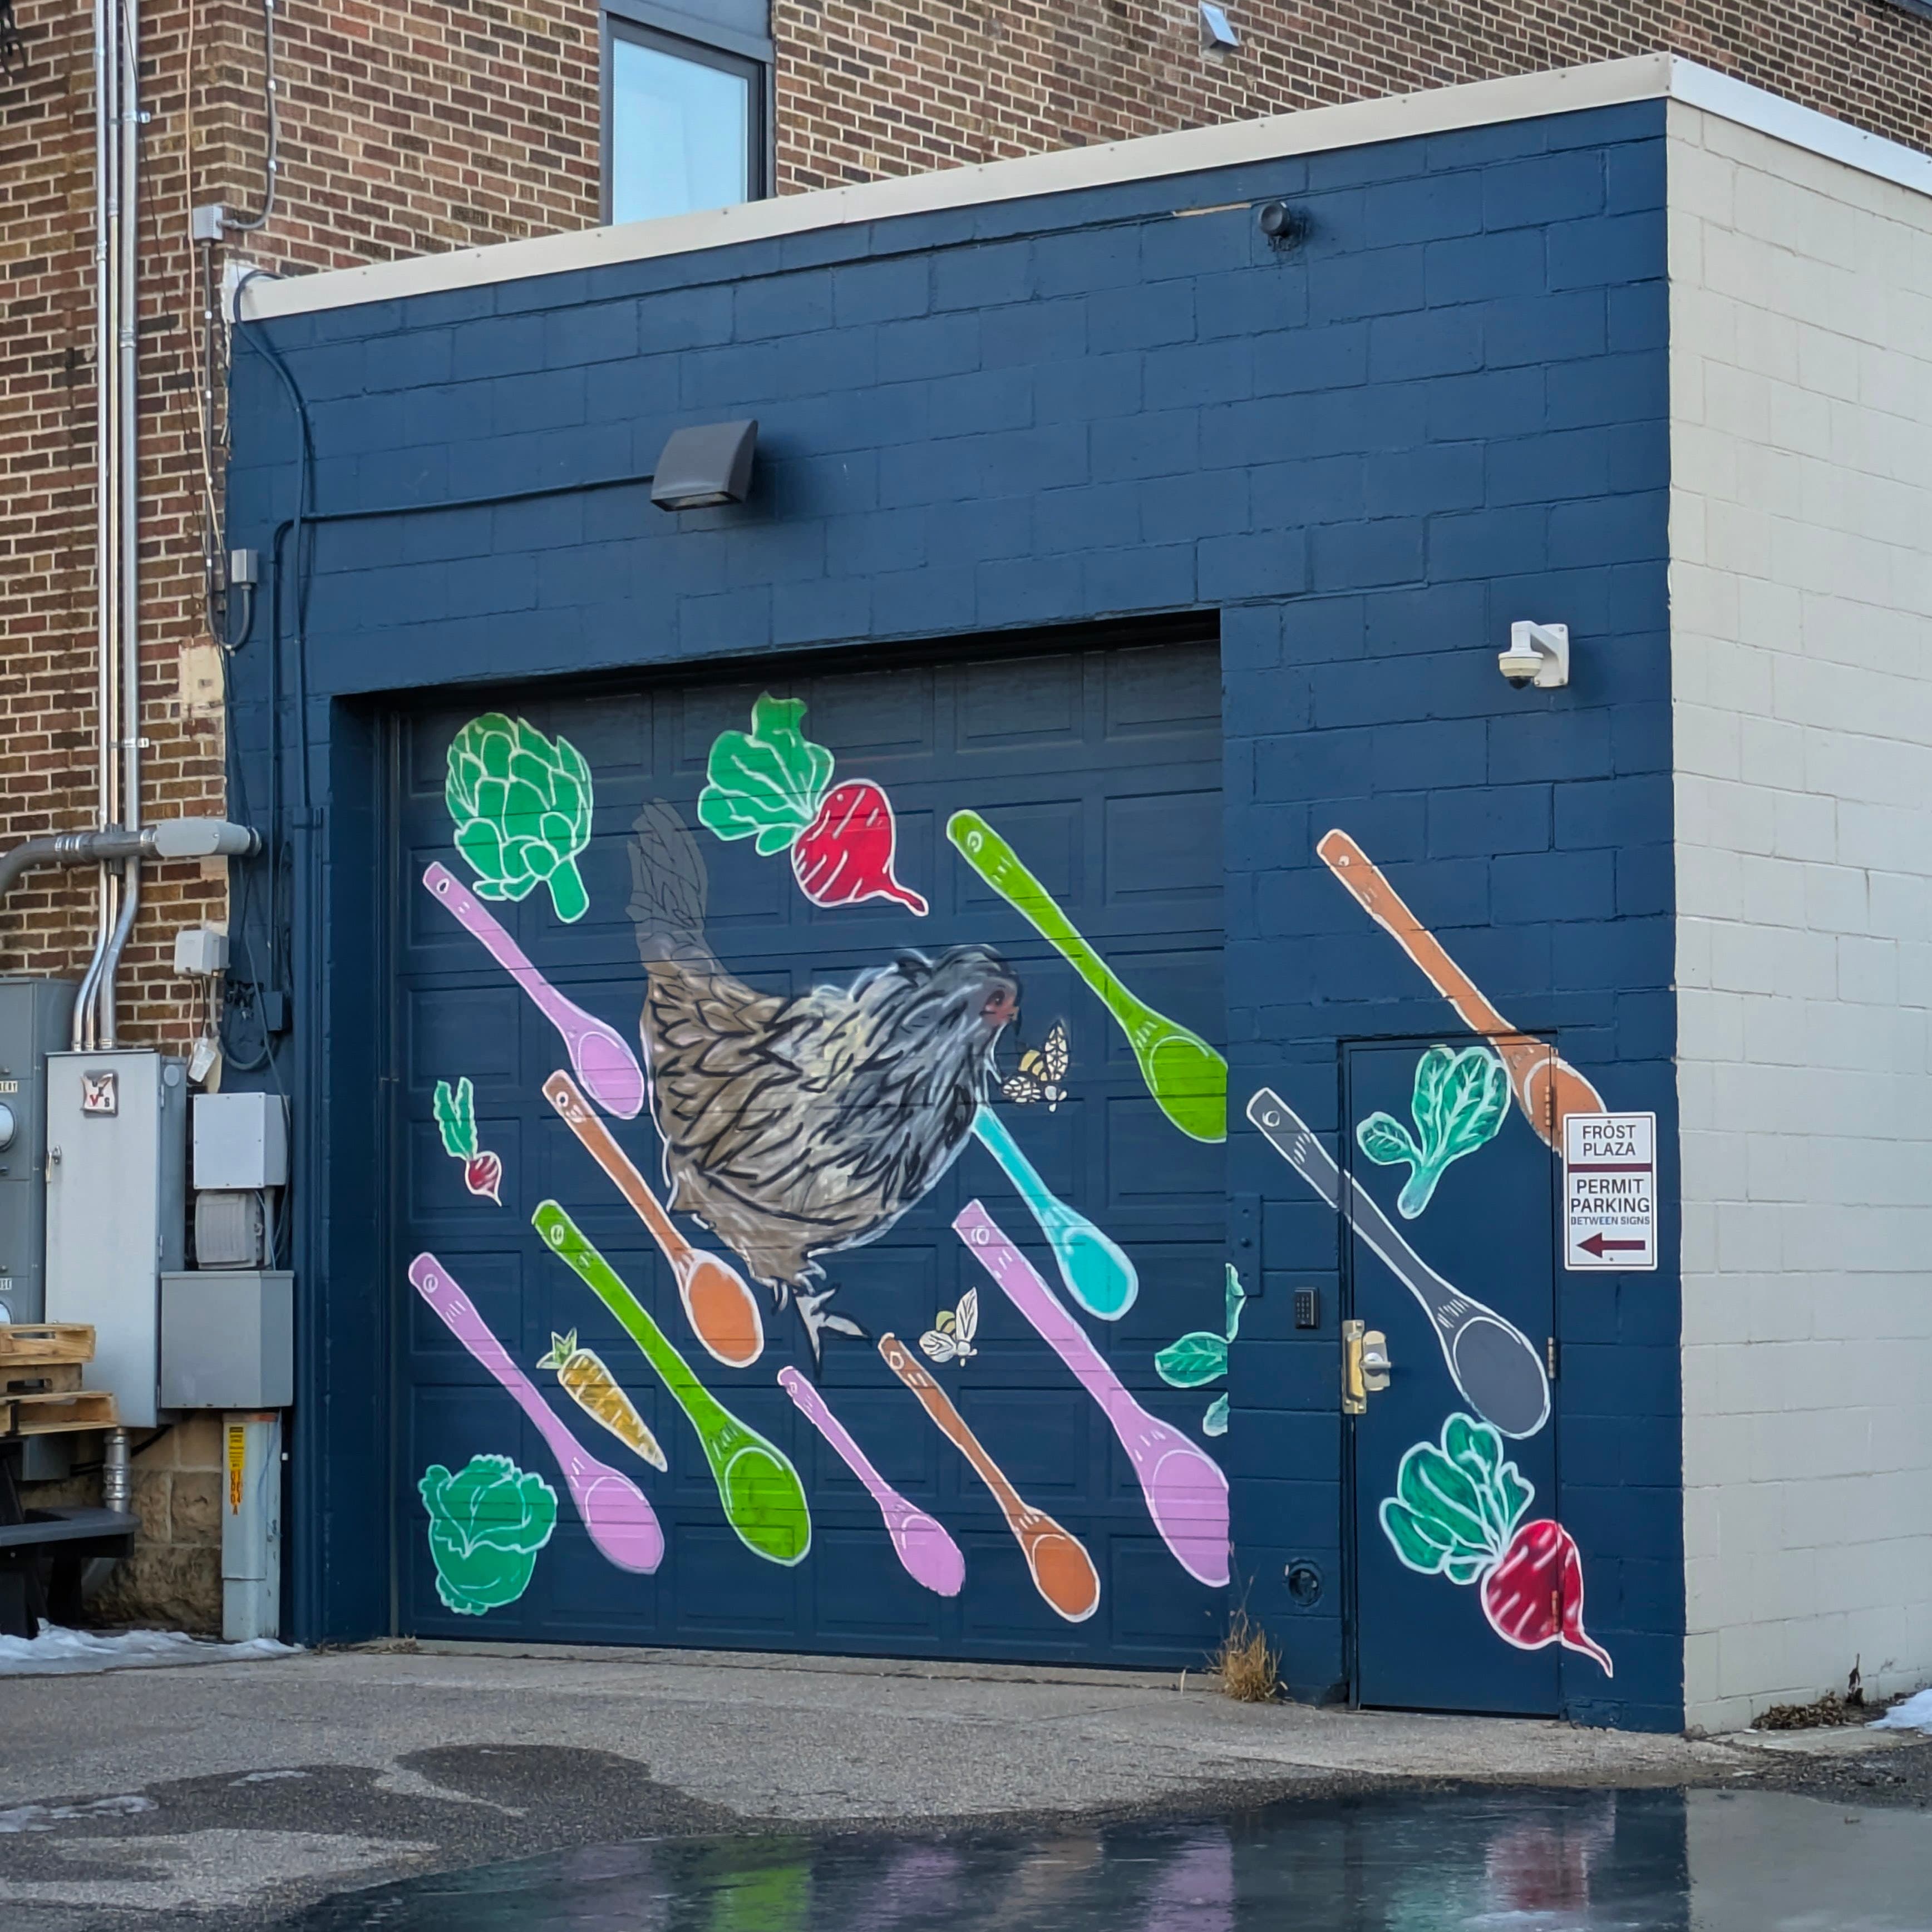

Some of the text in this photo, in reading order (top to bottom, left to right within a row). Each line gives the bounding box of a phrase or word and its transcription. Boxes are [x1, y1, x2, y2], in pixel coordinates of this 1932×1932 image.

[1583, 1125, 1636, 1140] FROST
[1583, 1142, 1636, 1157] PLAZA
[1576, 1179, 1644, 1194] PERMIT
[1571, 1197, 1650, 1213] PARKING
[1571, 1216, 1650, 1225] BETWEEN SIGNS
